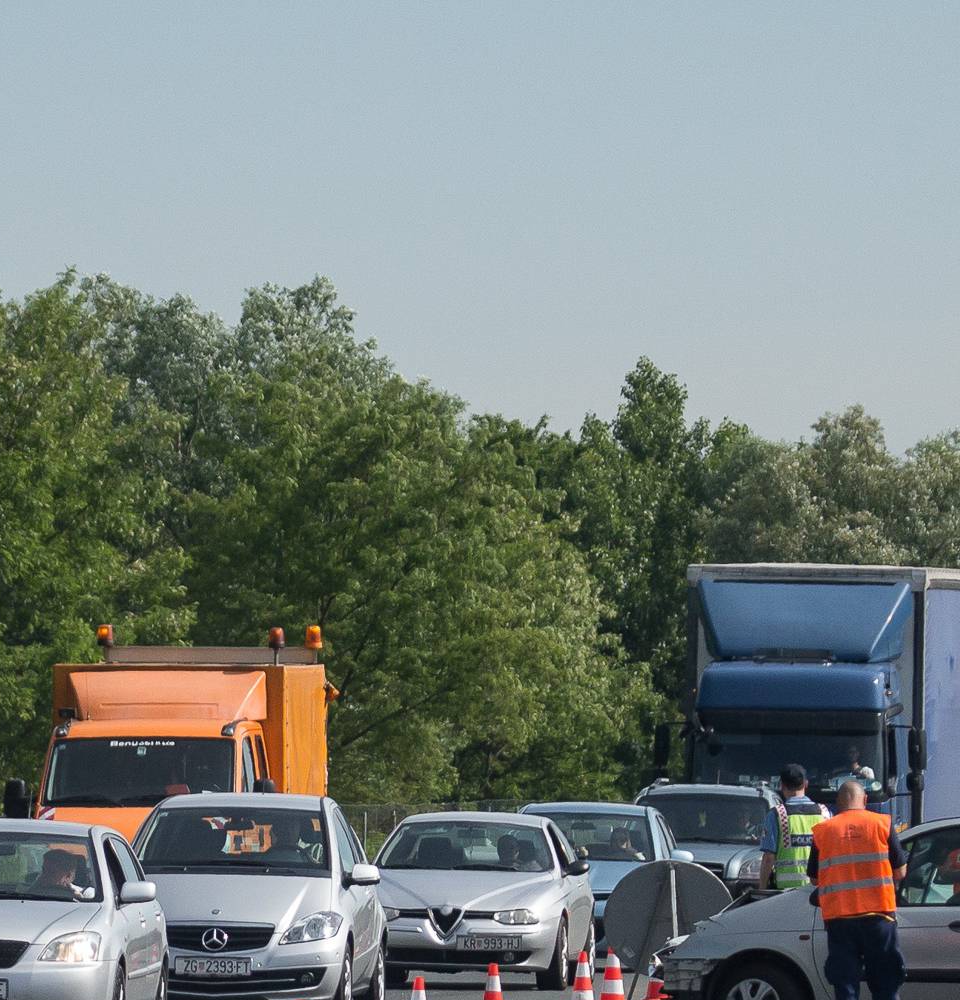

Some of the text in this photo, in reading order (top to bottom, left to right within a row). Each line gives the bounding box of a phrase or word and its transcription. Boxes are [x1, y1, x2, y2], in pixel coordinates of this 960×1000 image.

[791, 836, 813, 844] POLIC
[463, 937, 476, 949] KR
[183, 959, 198, 973] ZG
